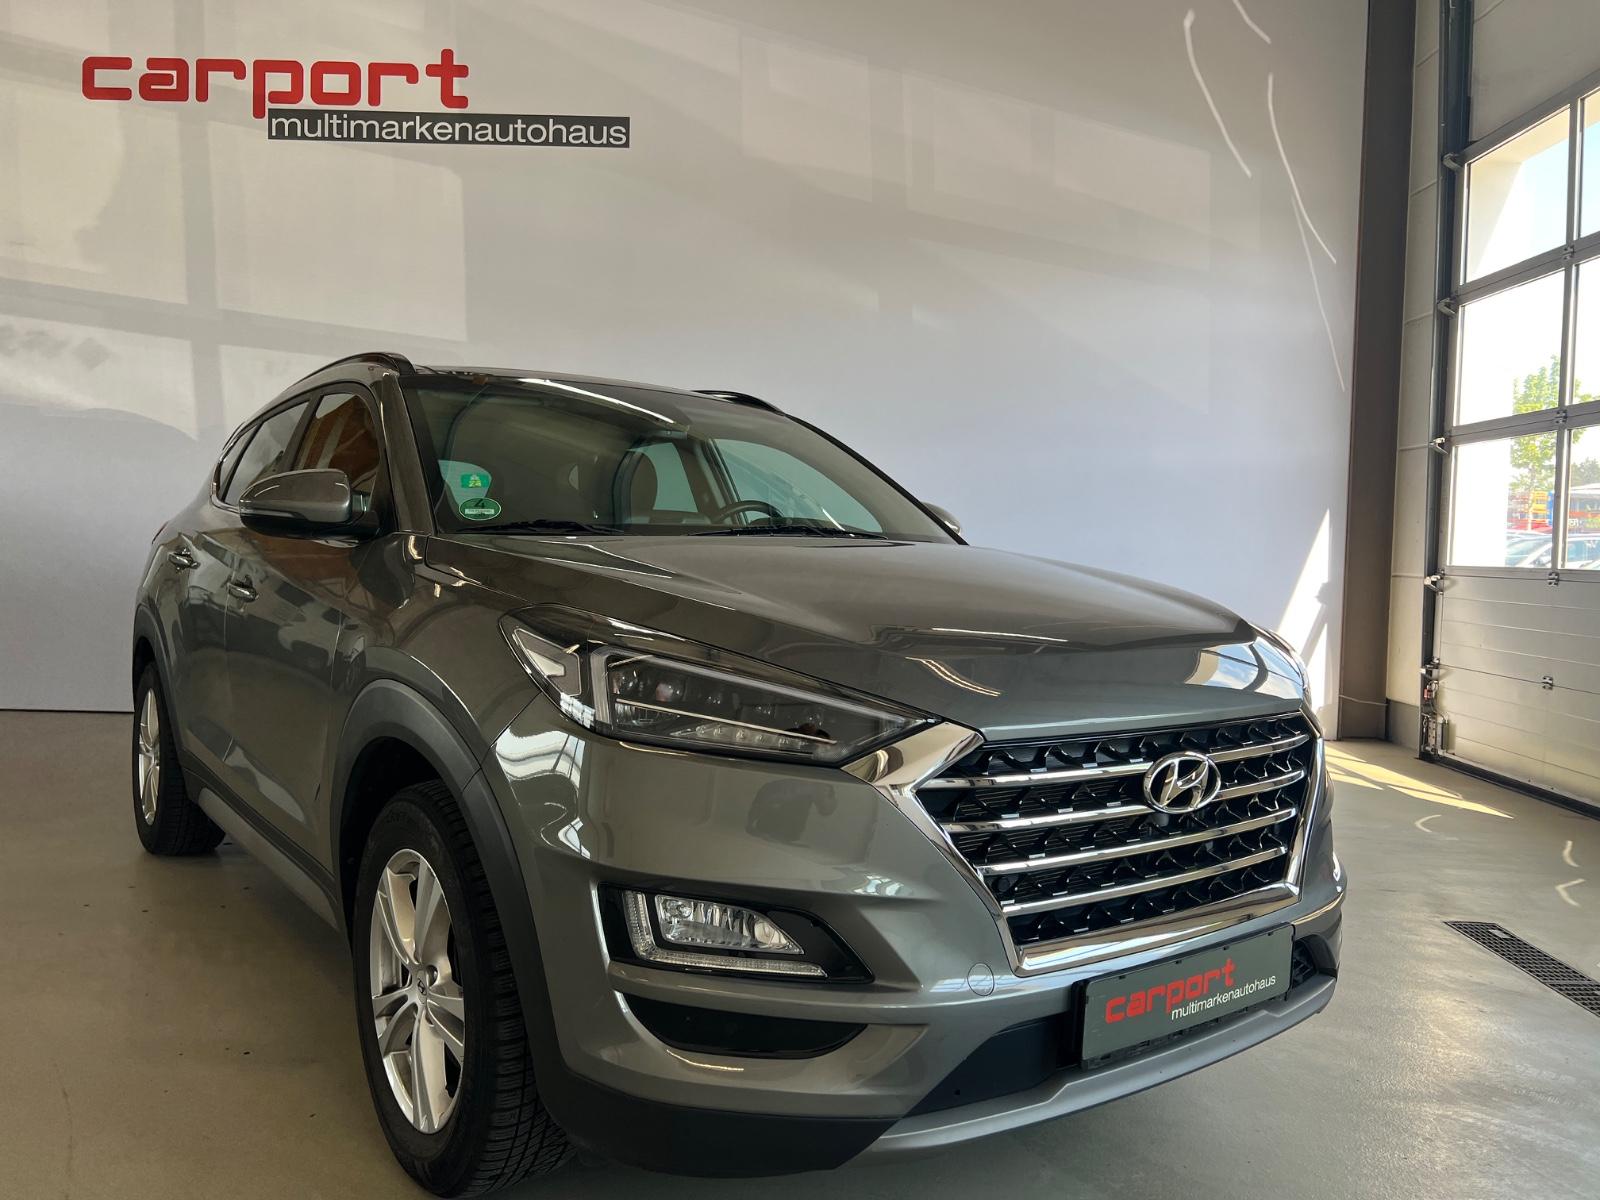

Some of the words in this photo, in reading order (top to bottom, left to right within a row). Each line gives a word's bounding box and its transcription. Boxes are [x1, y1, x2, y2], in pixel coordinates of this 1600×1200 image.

[82, 48, 469, 119] carport
[270, 113, 627, 145] multimarkenautohaus
[1105, 957, 1236, 1024] carport
[1171, 975, 1276, 1020] multimarkenautohaus
